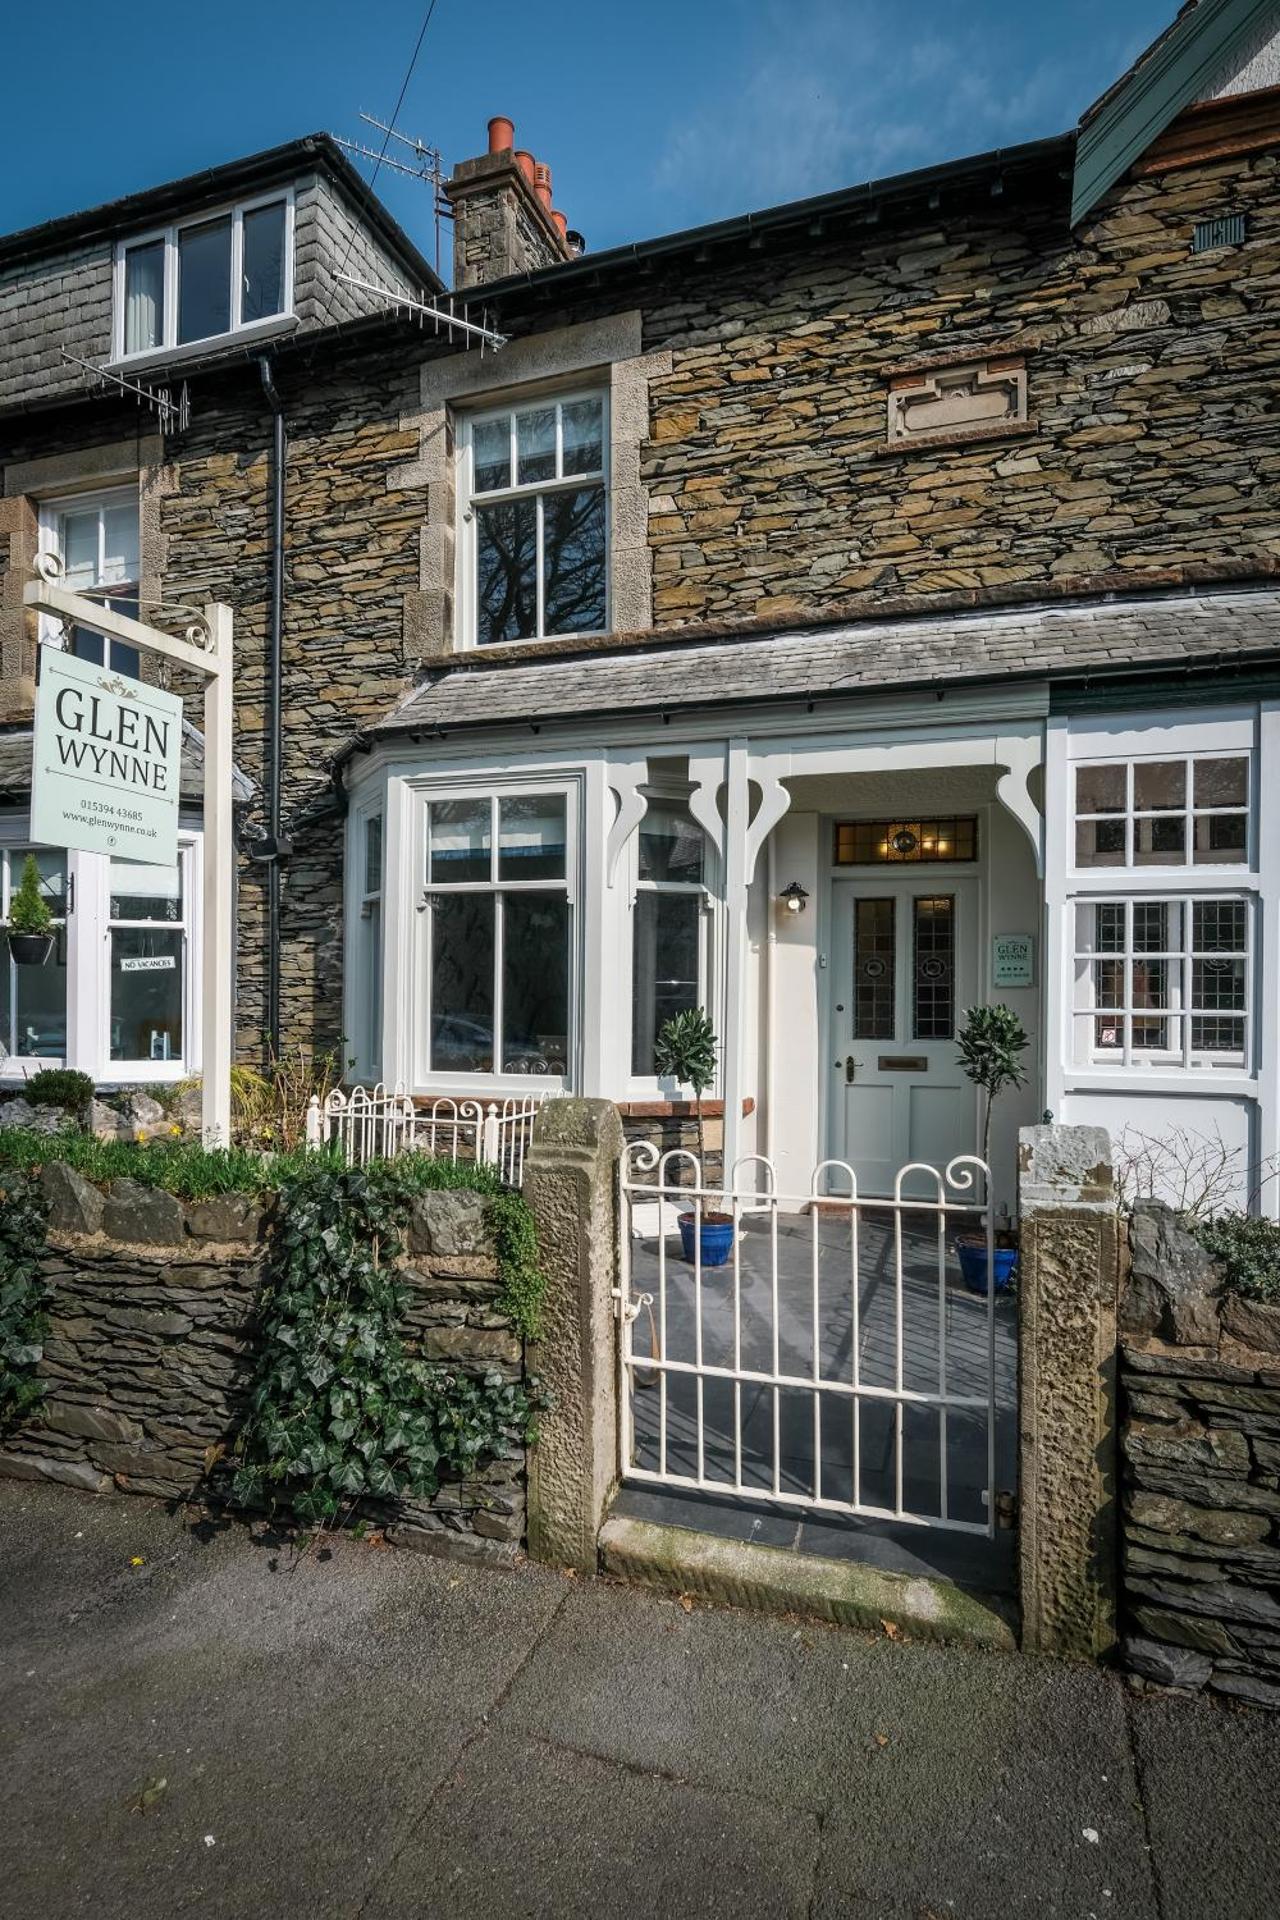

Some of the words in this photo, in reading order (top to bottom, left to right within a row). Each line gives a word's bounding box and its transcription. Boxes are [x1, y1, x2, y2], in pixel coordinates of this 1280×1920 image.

[55, 688, 170, 759] GLEN
[55, 734, 167, 791] WYNNE
[81, 799, 114, 815] 015394
[63, 811, 158, 838] www.glenwynne.co.uk
[998, 944, 1028, 954] GLEN
[138, 960, 171, 968] VACANCIES
